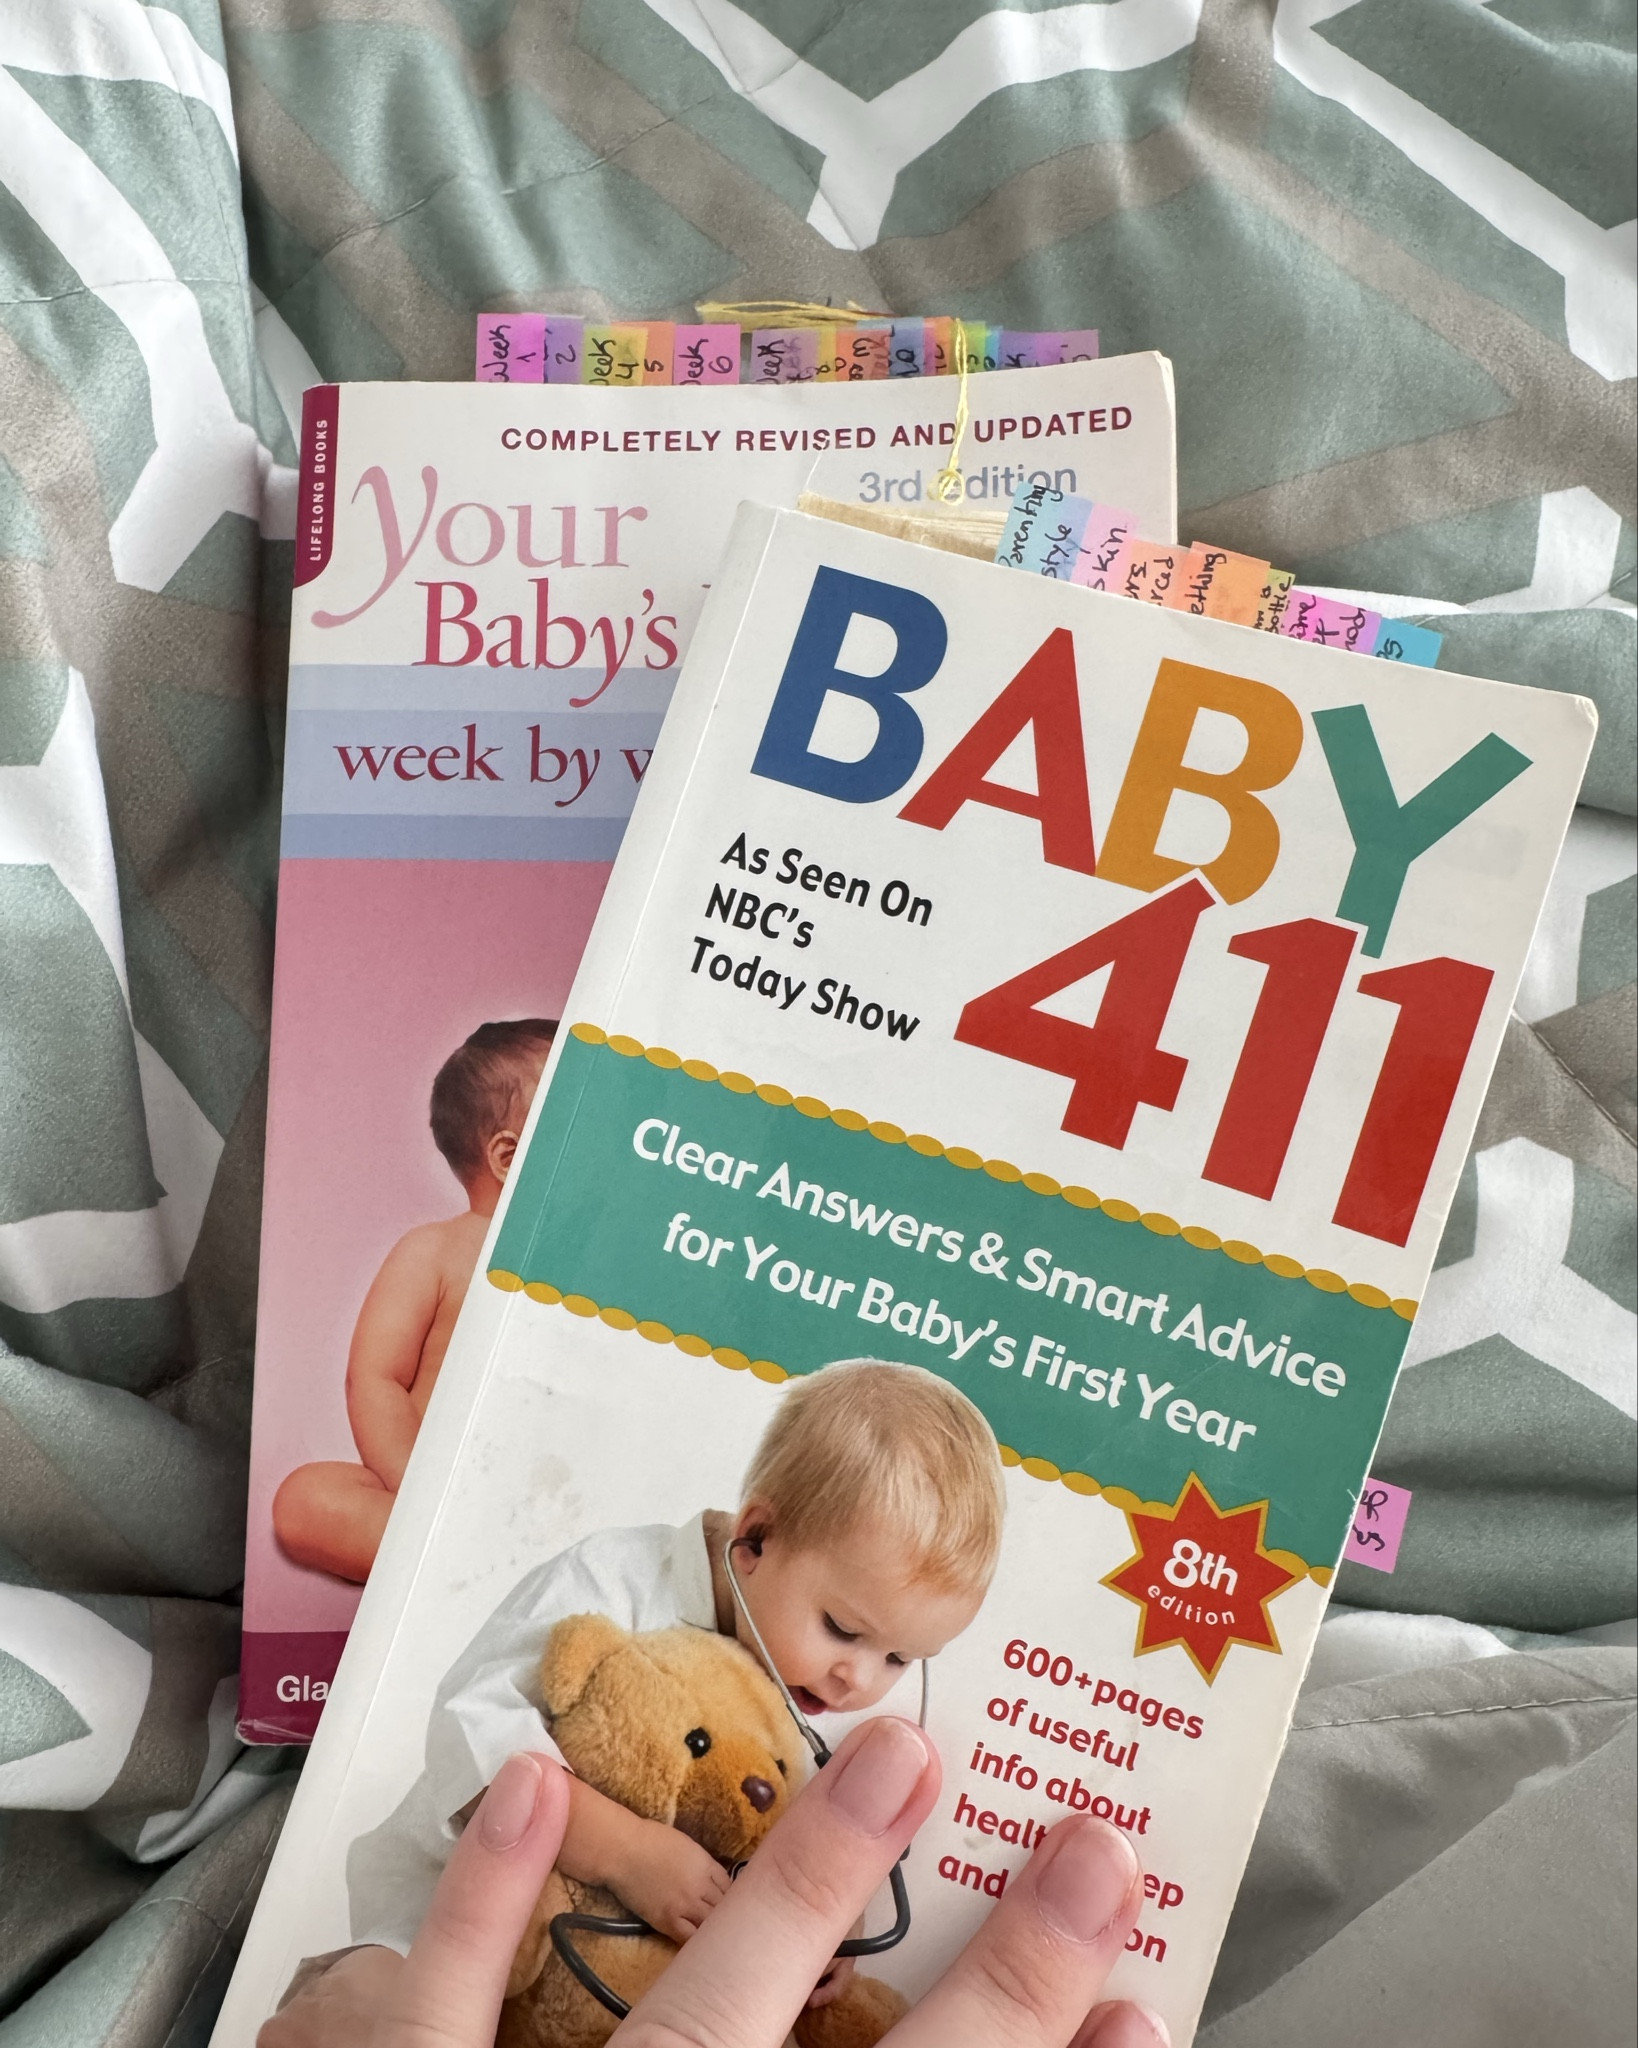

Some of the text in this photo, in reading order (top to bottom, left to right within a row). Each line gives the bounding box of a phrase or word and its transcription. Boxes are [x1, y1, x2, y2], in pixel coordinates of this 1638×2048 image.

[555, 344, 577, 365] 2
[615, 362, 640, 380] 4
[643, 357, 665, 373] 5
[708, 355, 734, 374] 6
[501, 405, 1132, 452] COMPLETELY REVISED AND UPDATED
[310, 419, 328, 562] LIFELONG BOOKS
[859, 470, 921, 502] 3rd
[311, 465, 648, 629] your
[411, 577, 679, 708] Baby's
[333, 723, 504, 782] week
[526, 724, 601, 808] by
[750, 565, 1533, 958] BABY
[719, 832, 933, 927] As Seen On
[704, 882, 815, 948] NBC's
[691, 936, 921, 1042] Today Show
[954, 877, 1495, 1248] 411
[633, 1119, 1347, 1398] Clear Answers & Smart Advice
[663, 1213, 1258, 1453] for Your Baby's First Year
[1163, 1538, 1239, 1597] 8th
[1147, 1585, 1236, 1626] edition
[276, 1674, 329, 1703] Gla
[987, 1697, 1140, 1772] of useful
[953, 1793, 1047, 1850] healt
[969, 1741, 1152, 1836] info about
[938, 1855, 1009, 1900] and
